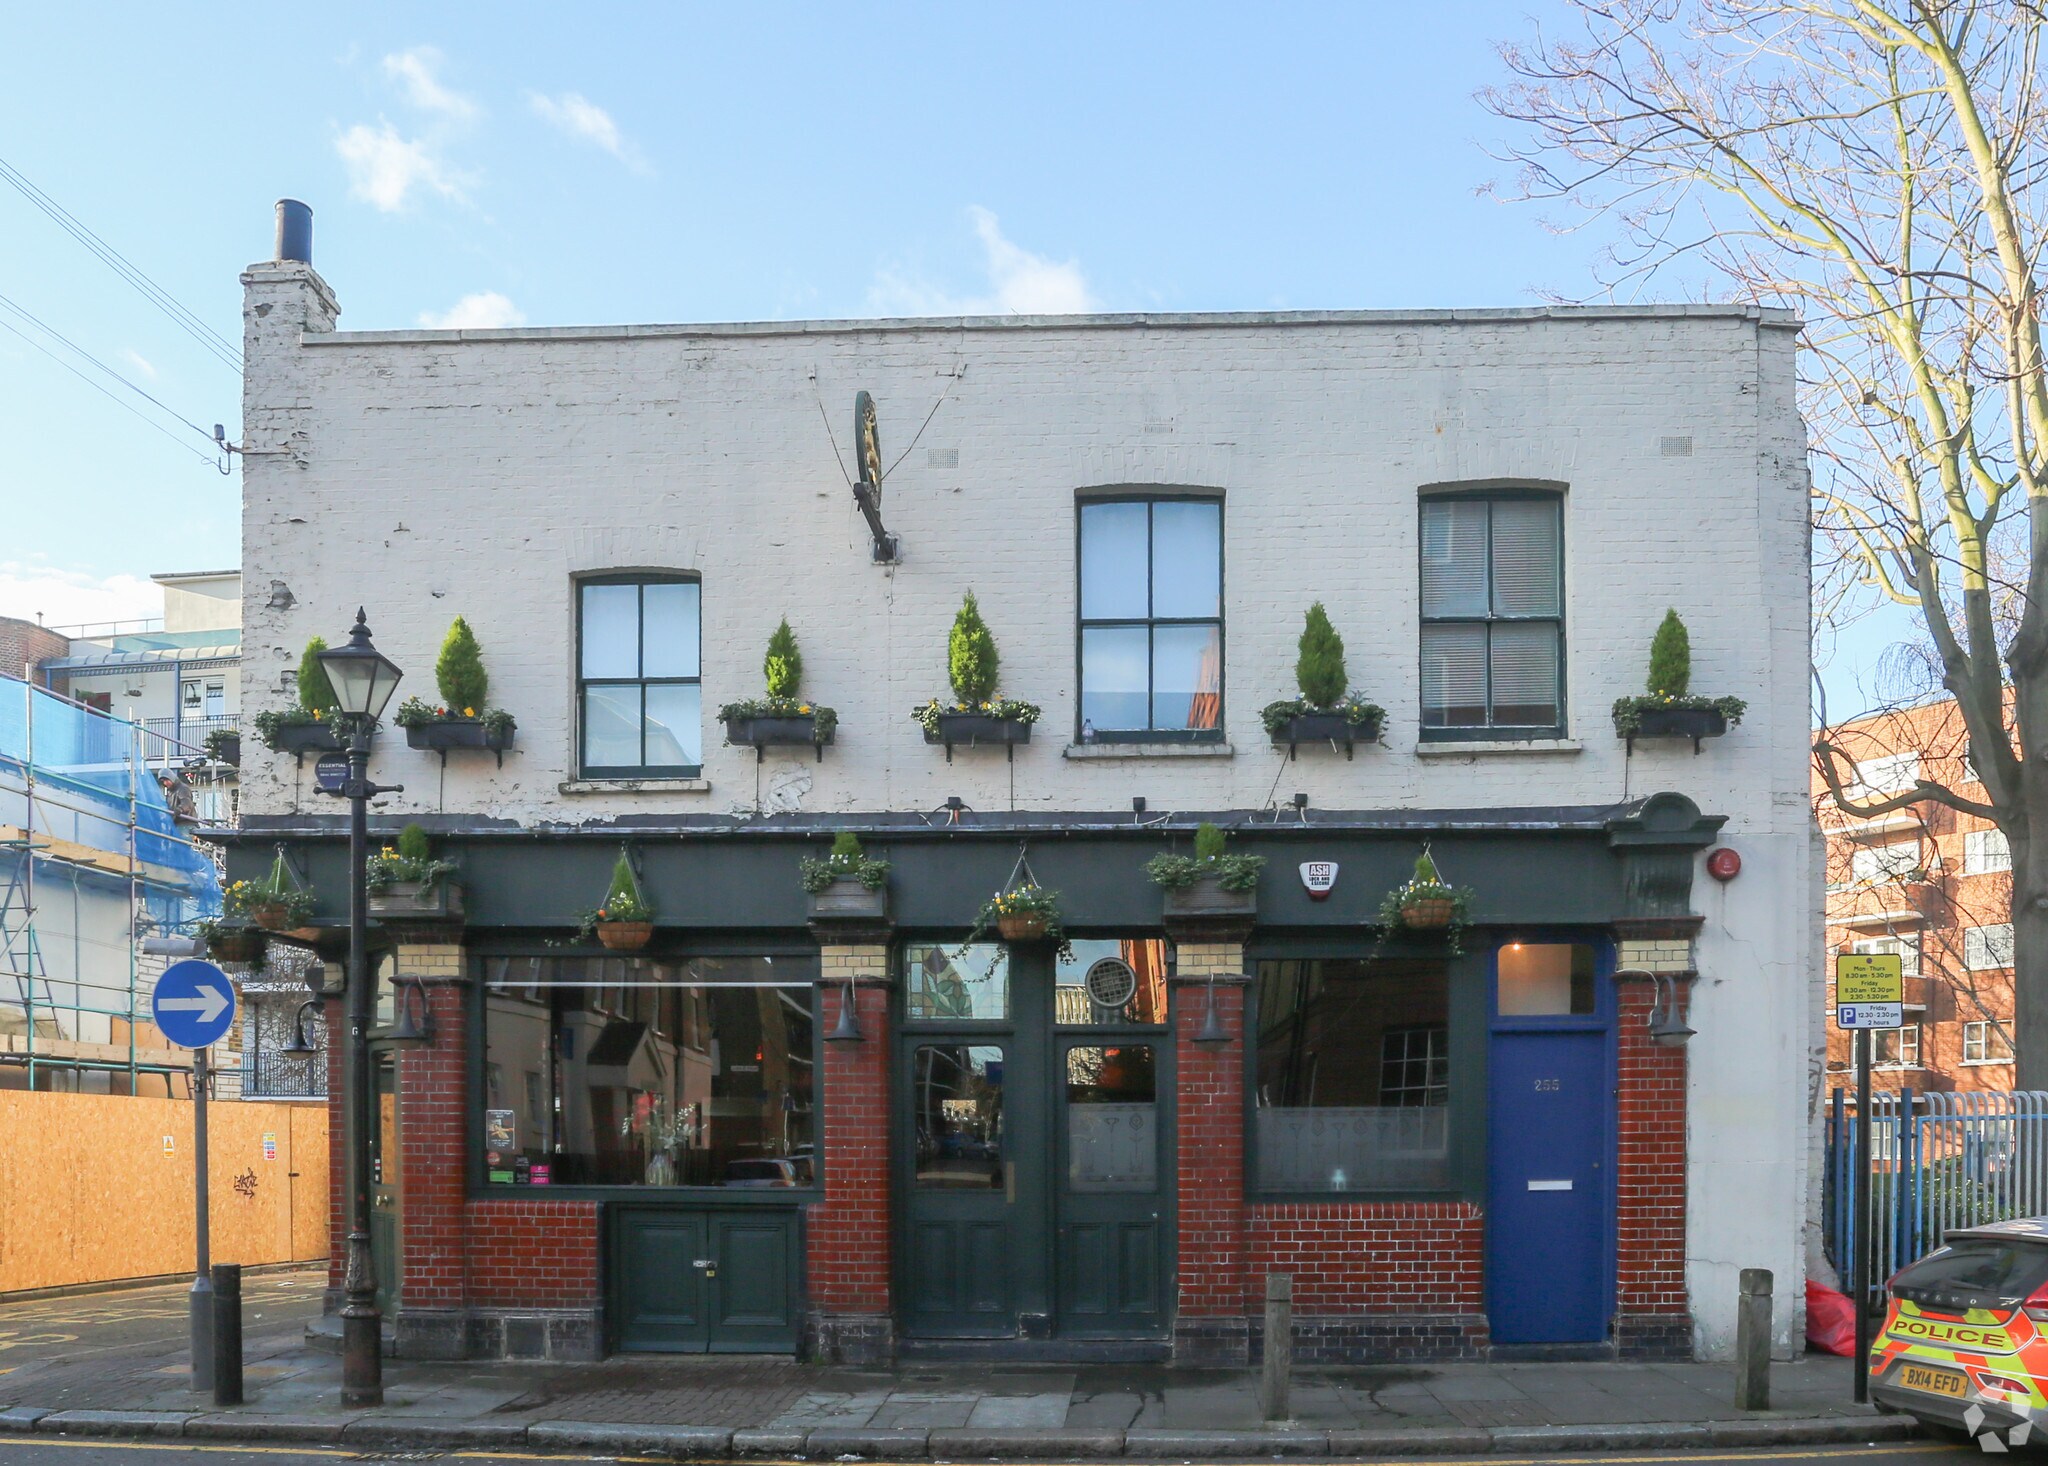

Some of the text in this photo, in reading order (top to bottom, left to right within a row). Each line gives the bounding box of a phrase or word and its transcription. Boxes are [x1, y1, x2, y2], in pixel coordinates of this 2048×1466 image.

[1310, 865, 1329, 875] ASH
[1844, 1009, 1854, 1022] P
[1534, 1080, 1560, 1091] 255
[1894, 1321, 2005, 1347] POLICE
[1907, 1369, 1959, 1392] BX14 EFD
